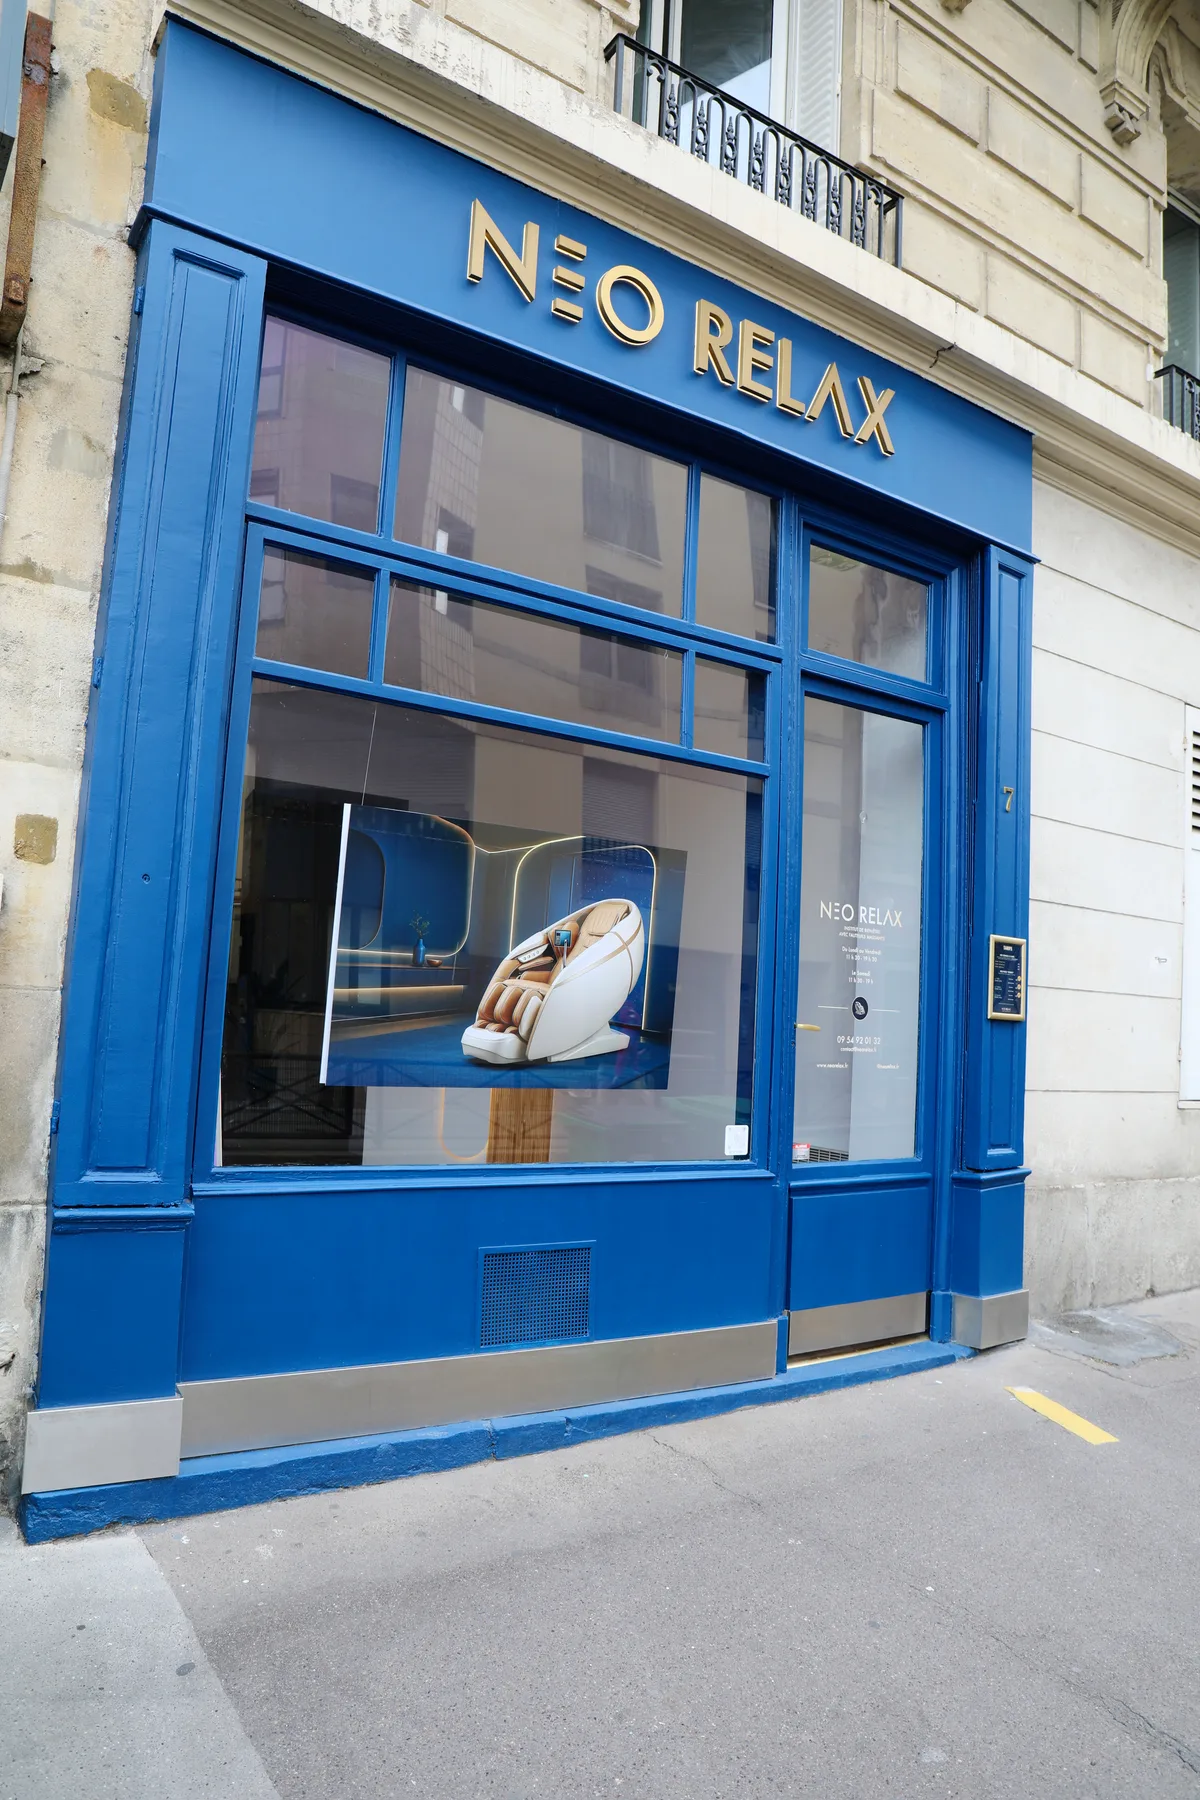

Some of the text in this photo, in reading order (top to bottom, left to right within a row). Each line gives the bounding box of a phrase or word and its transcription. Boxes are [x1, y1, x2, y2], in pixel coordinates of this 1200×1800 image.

[466, 198, 896, 457] NEO RELAX
[1003, 786, 1014, 812] 7
[820, 900, 902, 928] NEO RELAX
[836, 1035, 881, 1045] 09 54 92 01 32
